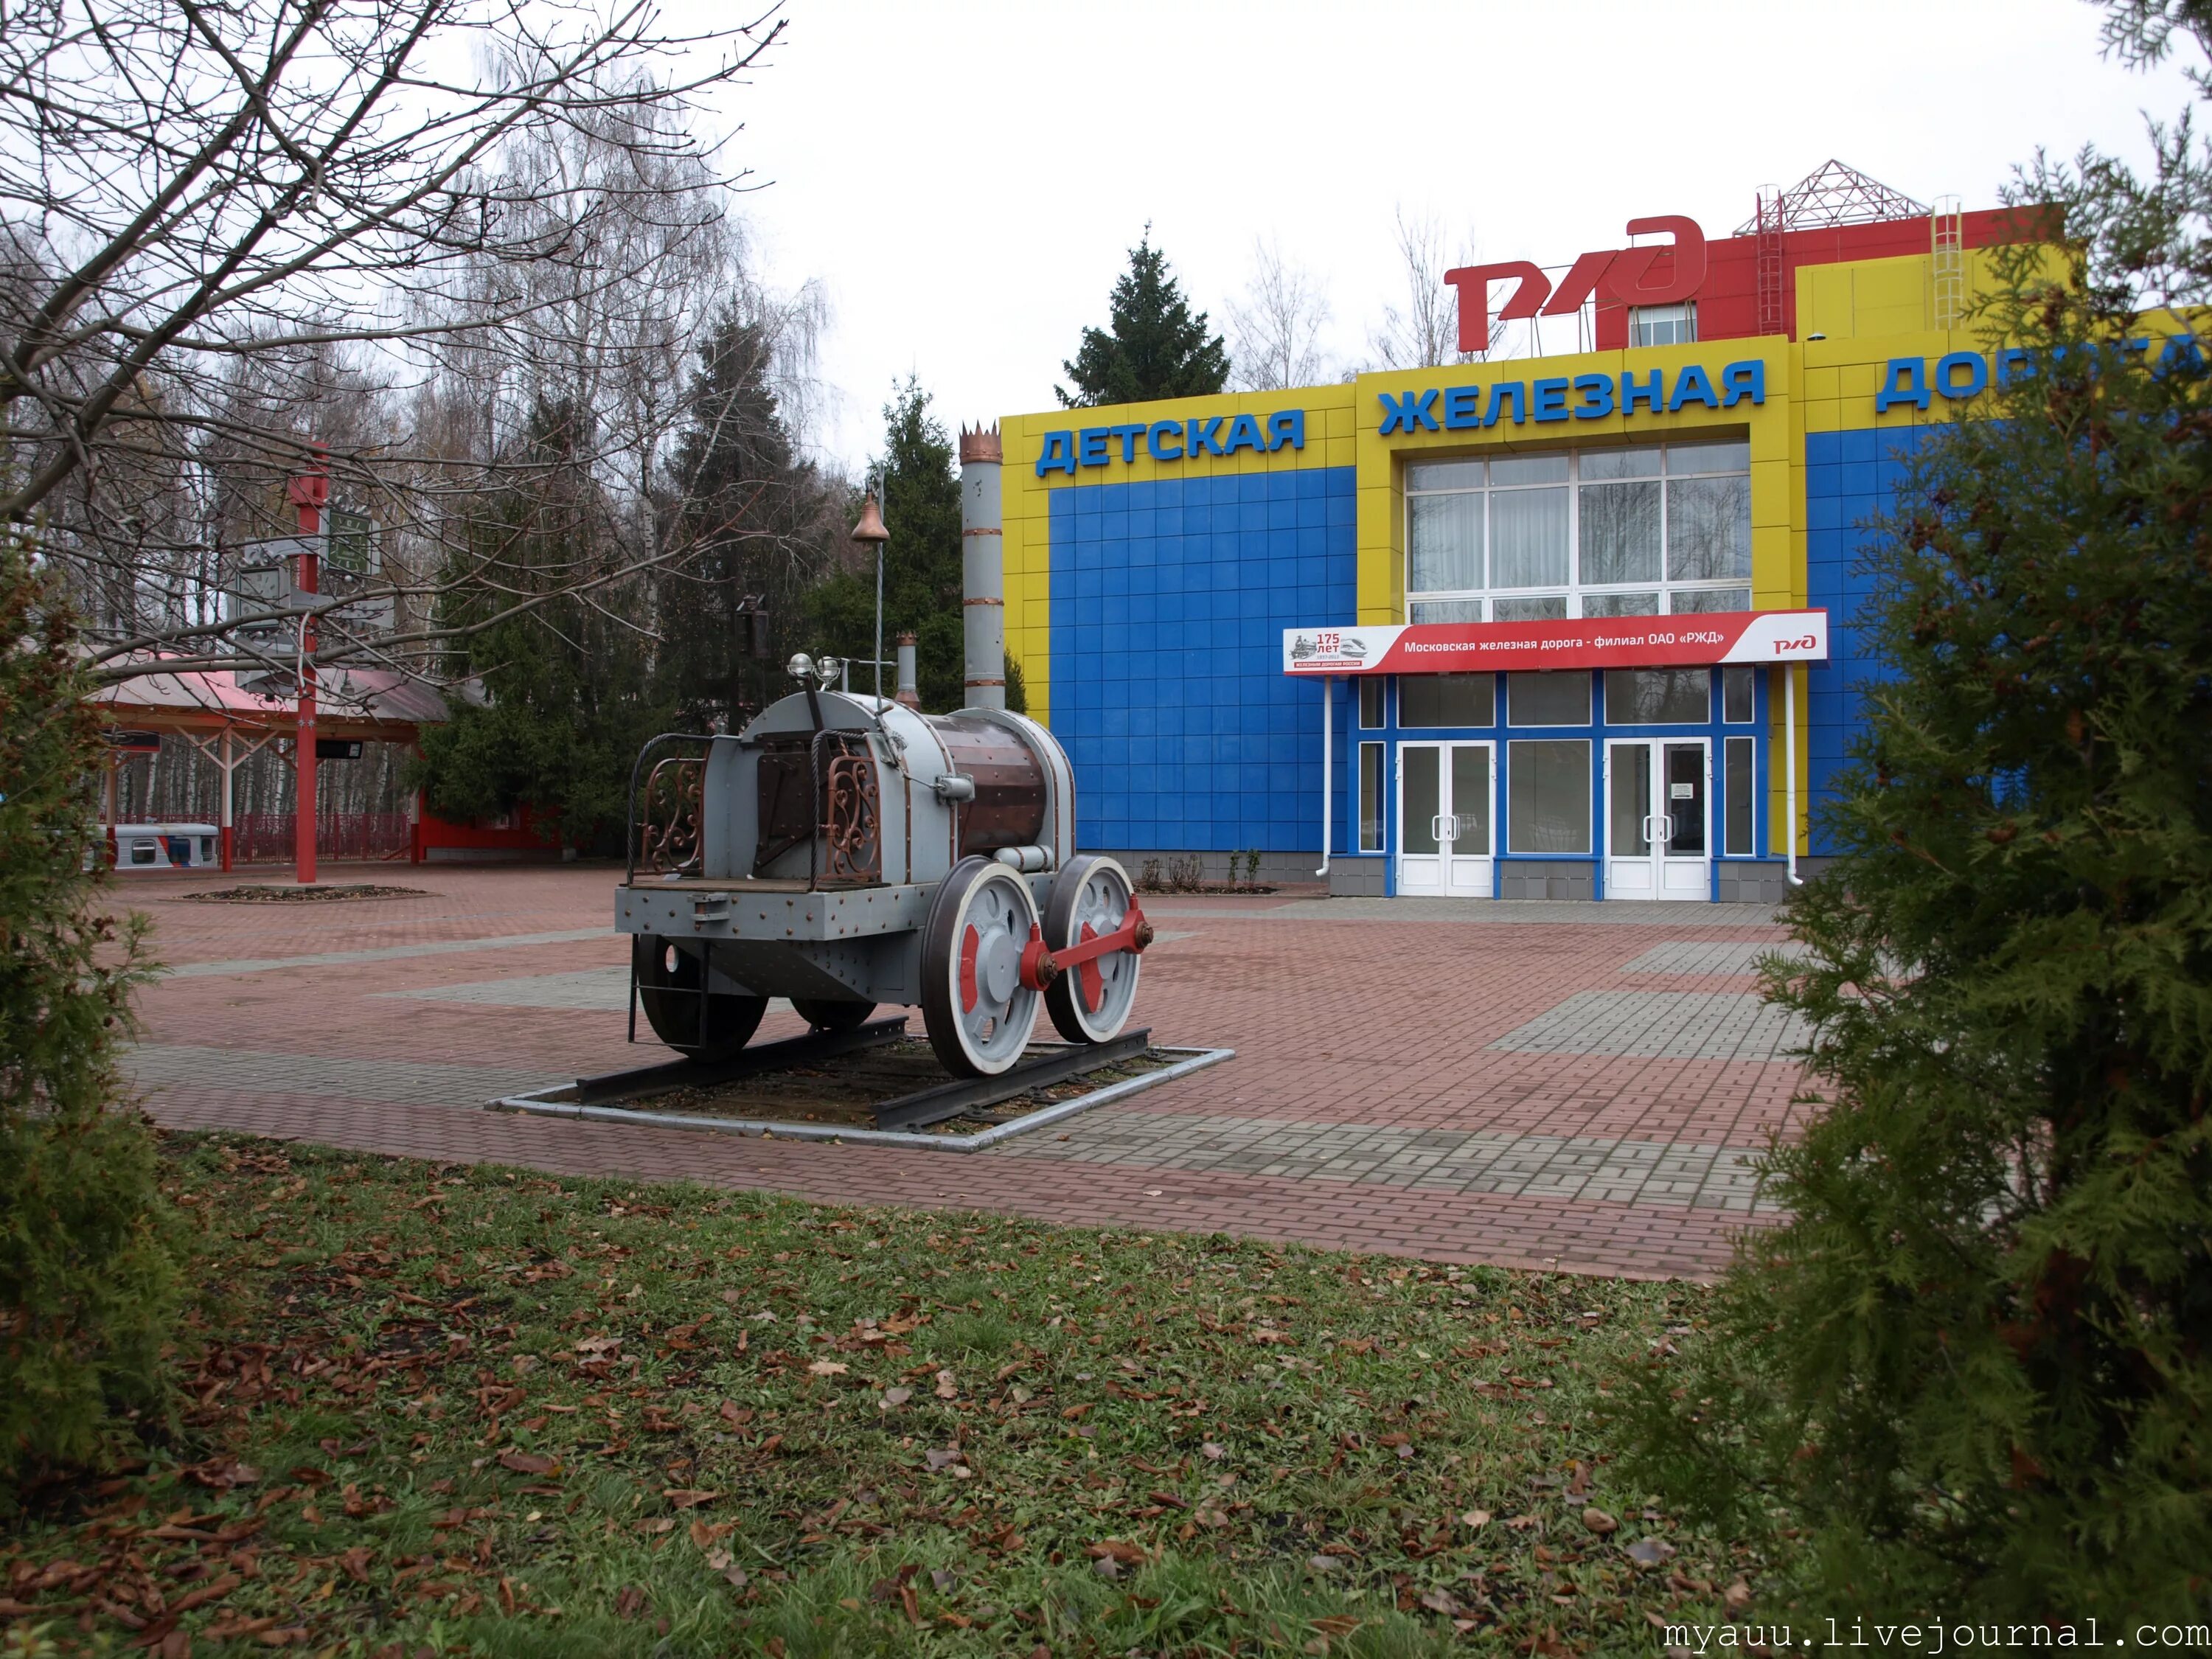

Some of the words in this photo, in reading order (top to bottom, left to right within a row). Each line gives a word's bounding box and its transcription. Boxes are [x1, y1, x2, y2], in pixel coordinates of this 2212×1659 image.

[1035, 408, 1304, 477] ДЕТСКАЯ
[1378, 359, 1766, 434] ЖЕЛЕЗНАЯ
[1317, 633, 1339, 644] 175
[1405, 641, 1475, 653] Московская
[1479, 640, 1537, 650] железная
[1540, 639, 1583, 650] дорога
[1594, 636, 1644, 649] филиал
[1648, 633, 1674, 644] ОАО
[1679, 631, 1724, 644] «РЖД»
[1317, 645, 1339, 653] лет
